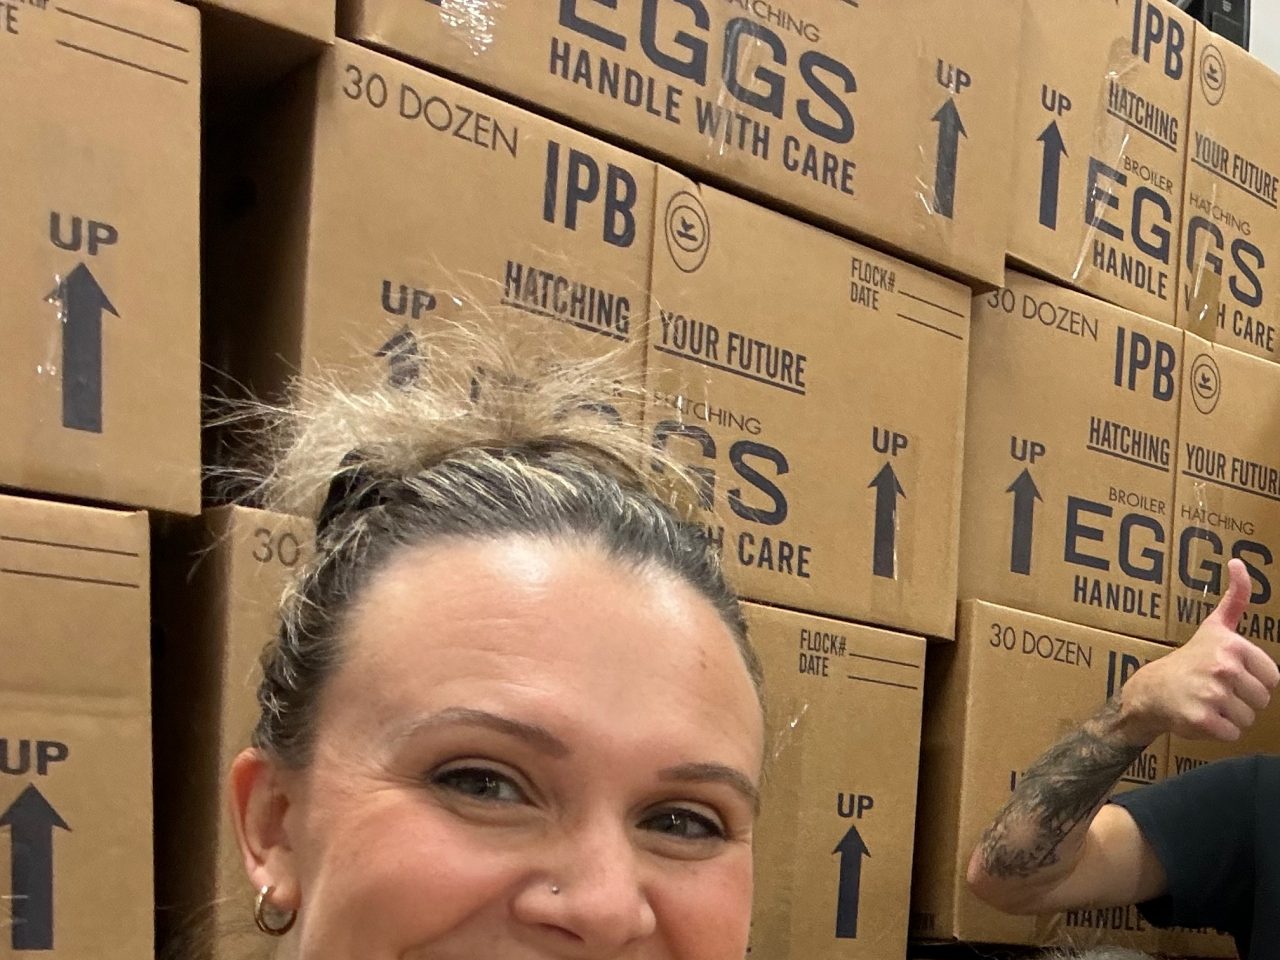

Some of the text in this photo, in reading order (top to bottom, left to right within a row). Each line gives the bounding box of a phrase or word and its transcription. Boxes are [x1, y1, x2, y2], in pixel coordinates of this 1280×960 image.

[1130, 0, 1185, 81] IPB
[936, 59, 972, 94] UP
[343, 65, 518, 158] 30 DOZEN
[549, 37, 857, 196] HANDLE WITH CARE
[1041, 84, 1072, 117] UP
[1107, 78, 1179, 145] HATCHING
[1122, 154, 1174, 195] BROILER
[1193, 131, 1280, 205] YOUR FUTURE
[542, 140, 638, 248] IPB
[1189, 192, 1252, 236] HATCHING
[50, 211, 118, 256] UP
[1084, 156, 1265, 308] EGGS
[851, 257, 895, 294] FLOCK#
[1093, 240, 1168, 301] HANDLE
[381, 280, 436, 320] UP
[505, 260, 630, 335] HATCHING
[850, 282, 879, 310] DATE
[987, 288, 1099, 342] 30 DOZEN
[660, 311, 806, 388] YOUR FUTURE
[1233, 310, 1276, 352] CARE
[1113, 326, 1175, 402] IPB
[872, 426, 908, 457] UP
[1010, 436, 1046, 465] UP
[1088, 416, 1171, 467] HATCHING
[1185, 442, 1226, 482] YOUR
[1109, 486, 1166, 516] BROILER
[1181, 505, 1255, 536] HATCHING
[252, 528, 300, 567] 30
[738, 532, 813, 579] CARE
[1063, 495, 1274, 605] EGGS
[1074, 575, 1162, 620] HANDLE
[1176, 596, 1217, 629] WIT
[800, 629, 847, 656] FLOCK#
[989, 623, 1093, 669] 30 DOZEN
[799, 652, 829, 679] DATE
[0, 740, 69, 776] UP
[837, 792, 874, 819] UP
